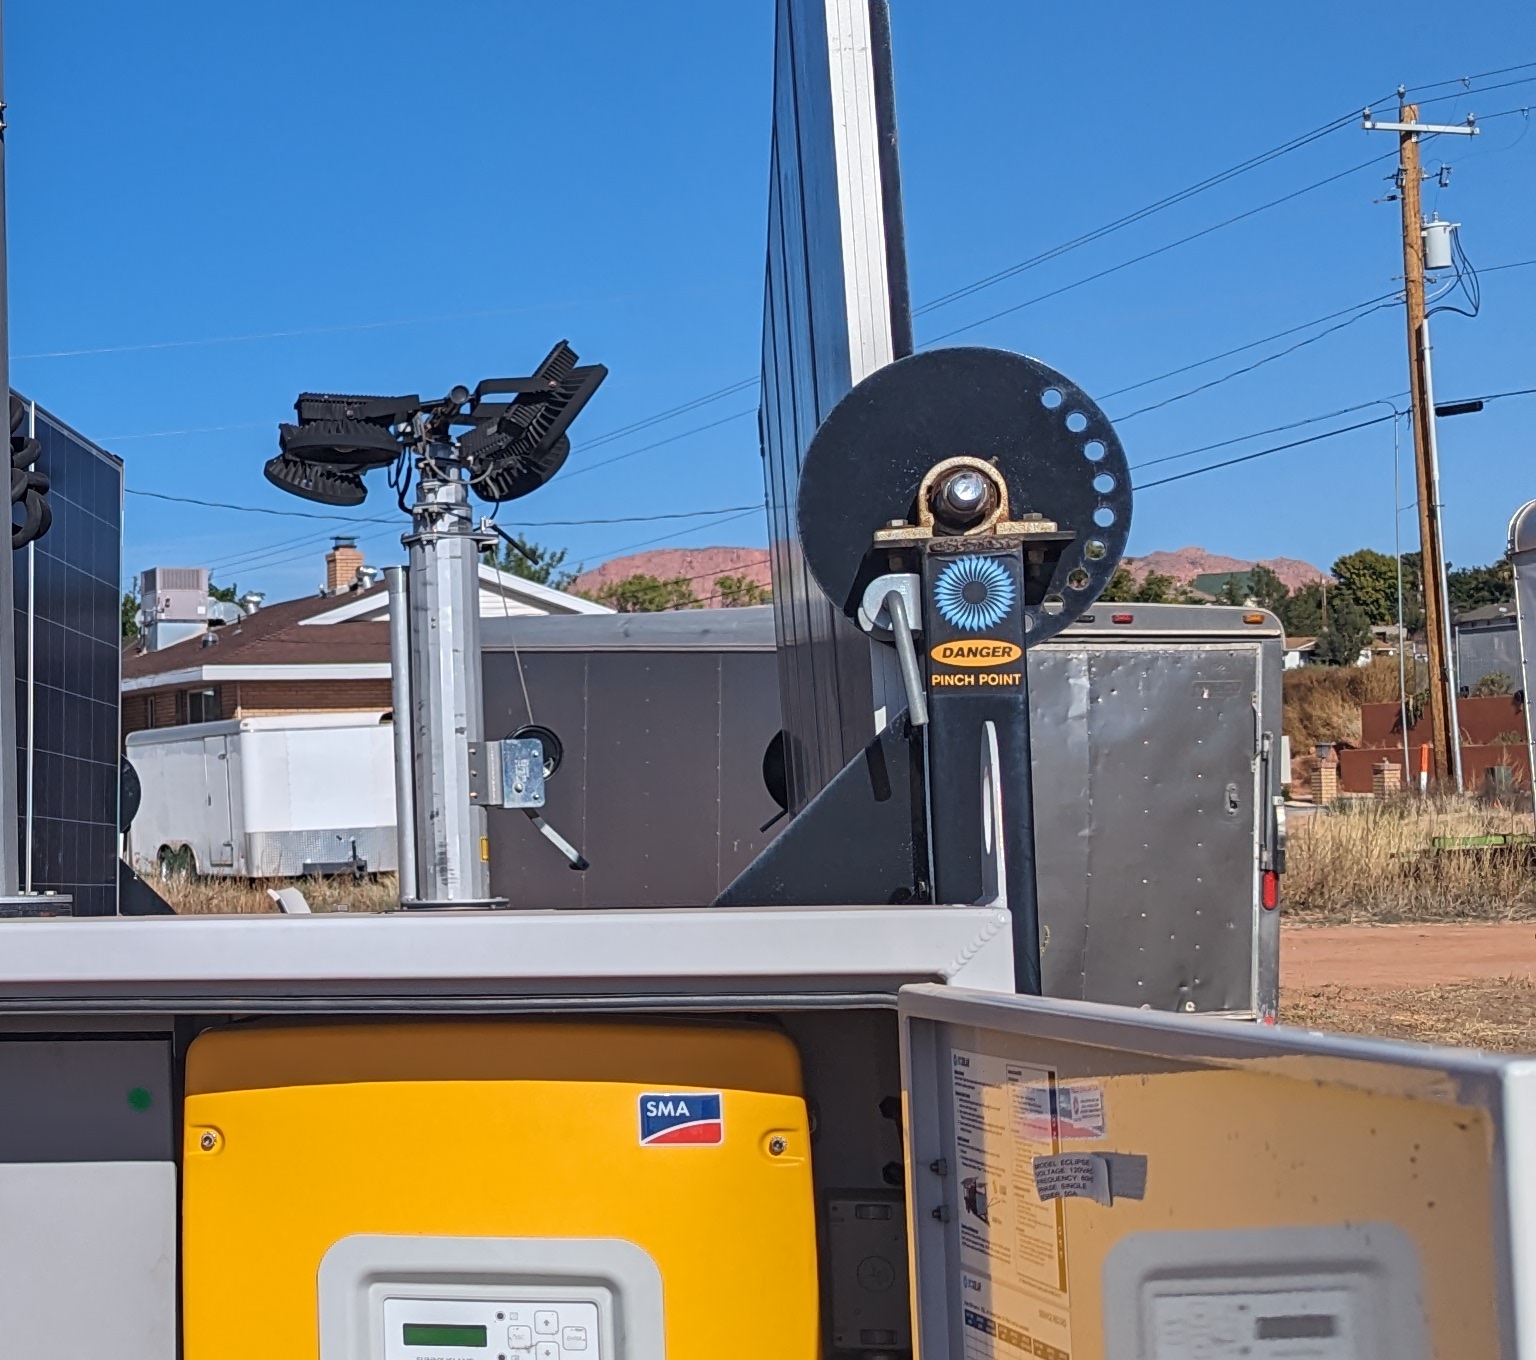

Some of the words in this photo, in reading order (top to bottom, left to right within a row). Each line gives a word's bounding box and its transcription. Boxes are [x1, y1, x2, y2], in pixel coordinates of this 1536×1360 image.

[941, 646, 1013, 659] DANGER
[931, 674, 975, 686] PINCH
[978, 673, 1022, 686] POINT
[646, 1100, 691, 1117] SMA
